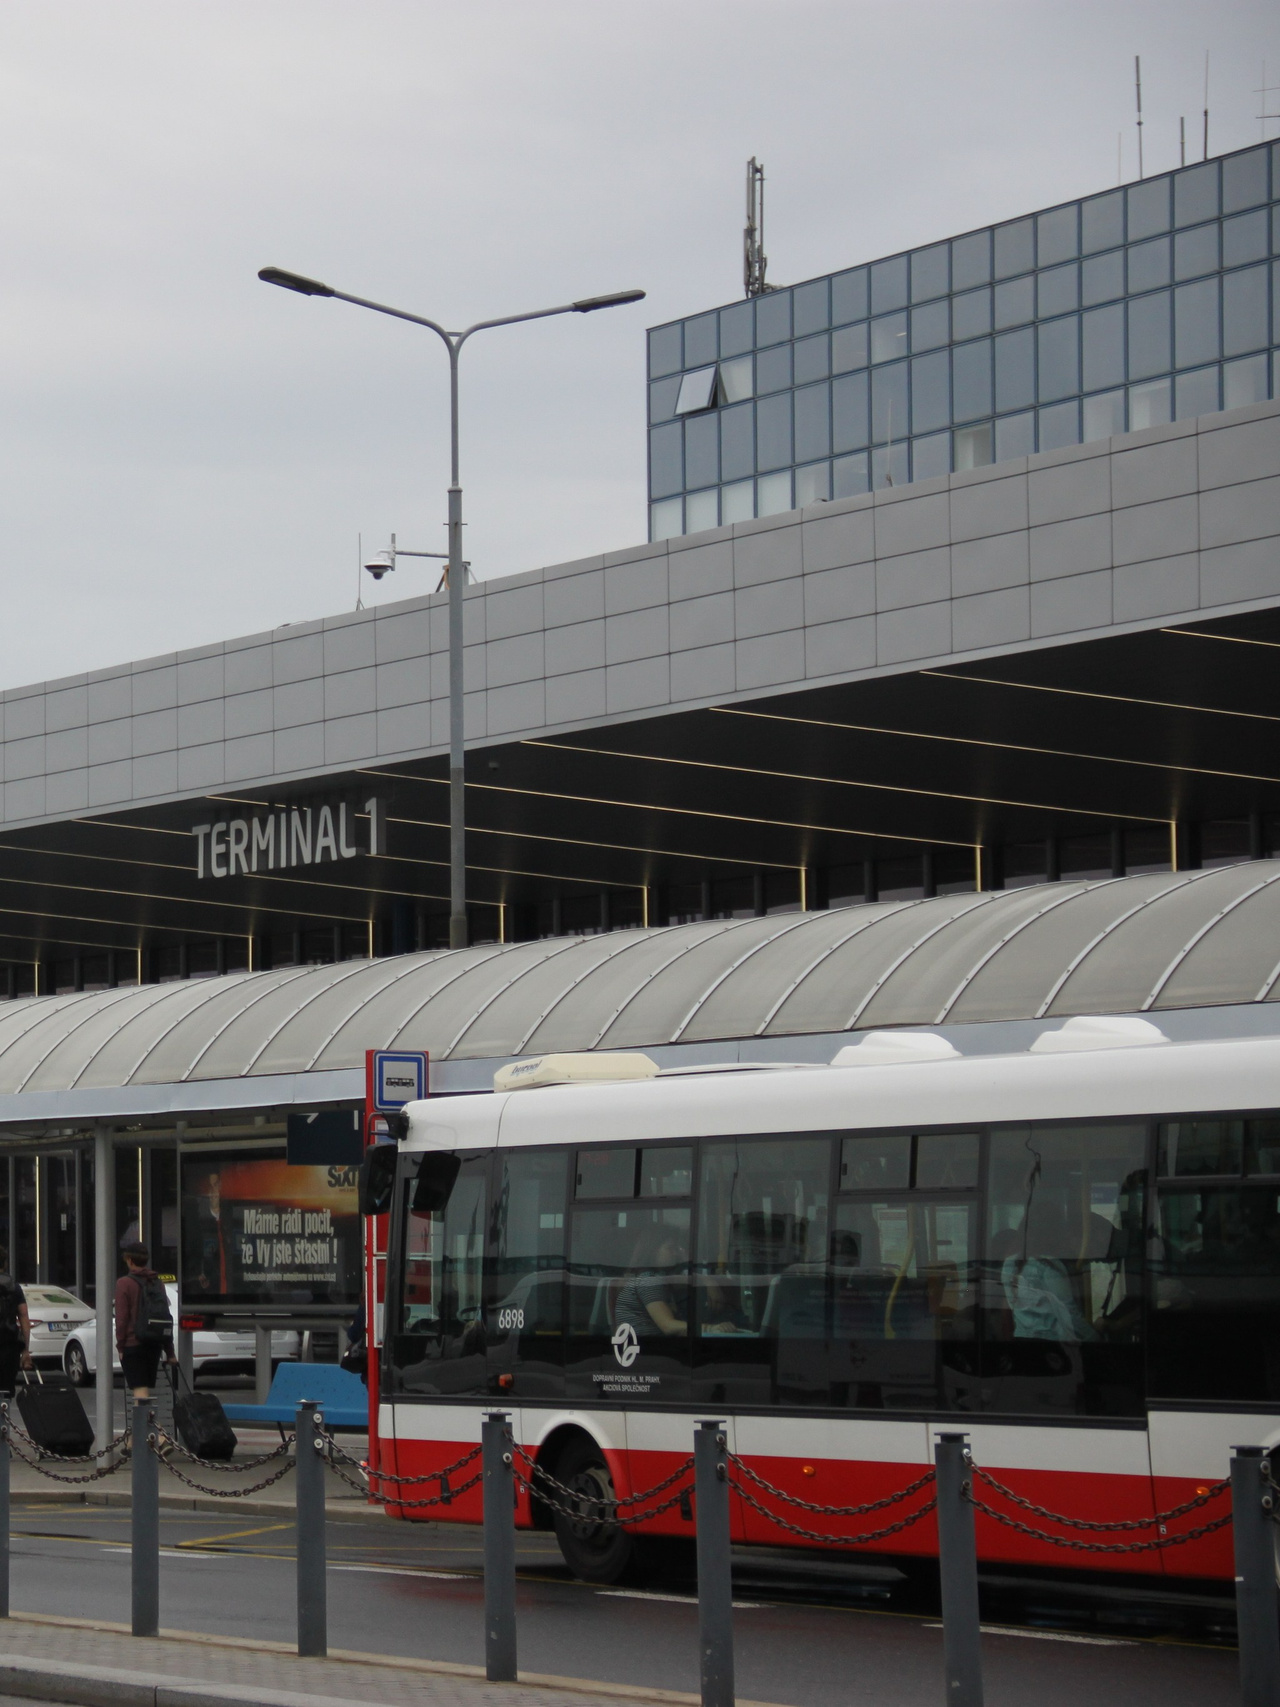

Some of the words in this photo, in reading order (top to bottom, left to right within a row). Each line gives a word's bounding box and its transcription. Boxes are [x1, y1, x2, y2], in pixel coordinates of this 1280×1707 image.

[192, 802, 356, 879] TERMINAL
[365, 797, 377, 855] 1
[244, 1209, 279, 1234] Máme
[282, 1208, 302, 1234] rádi
[305, 1208, 334, 1236] pocit,
[242, 1238, 253, 1264] že
[256, 1239, 271, 1267] Vy
[273, 1239, 292, 1267] jste
[295, 1238, 330, 1264] šťastní
[333, 1238, 338, 1264] !
[499, 1309, 524, 1328] 6898
[622, 1384, 650, 1392] SPOLEČNOST
